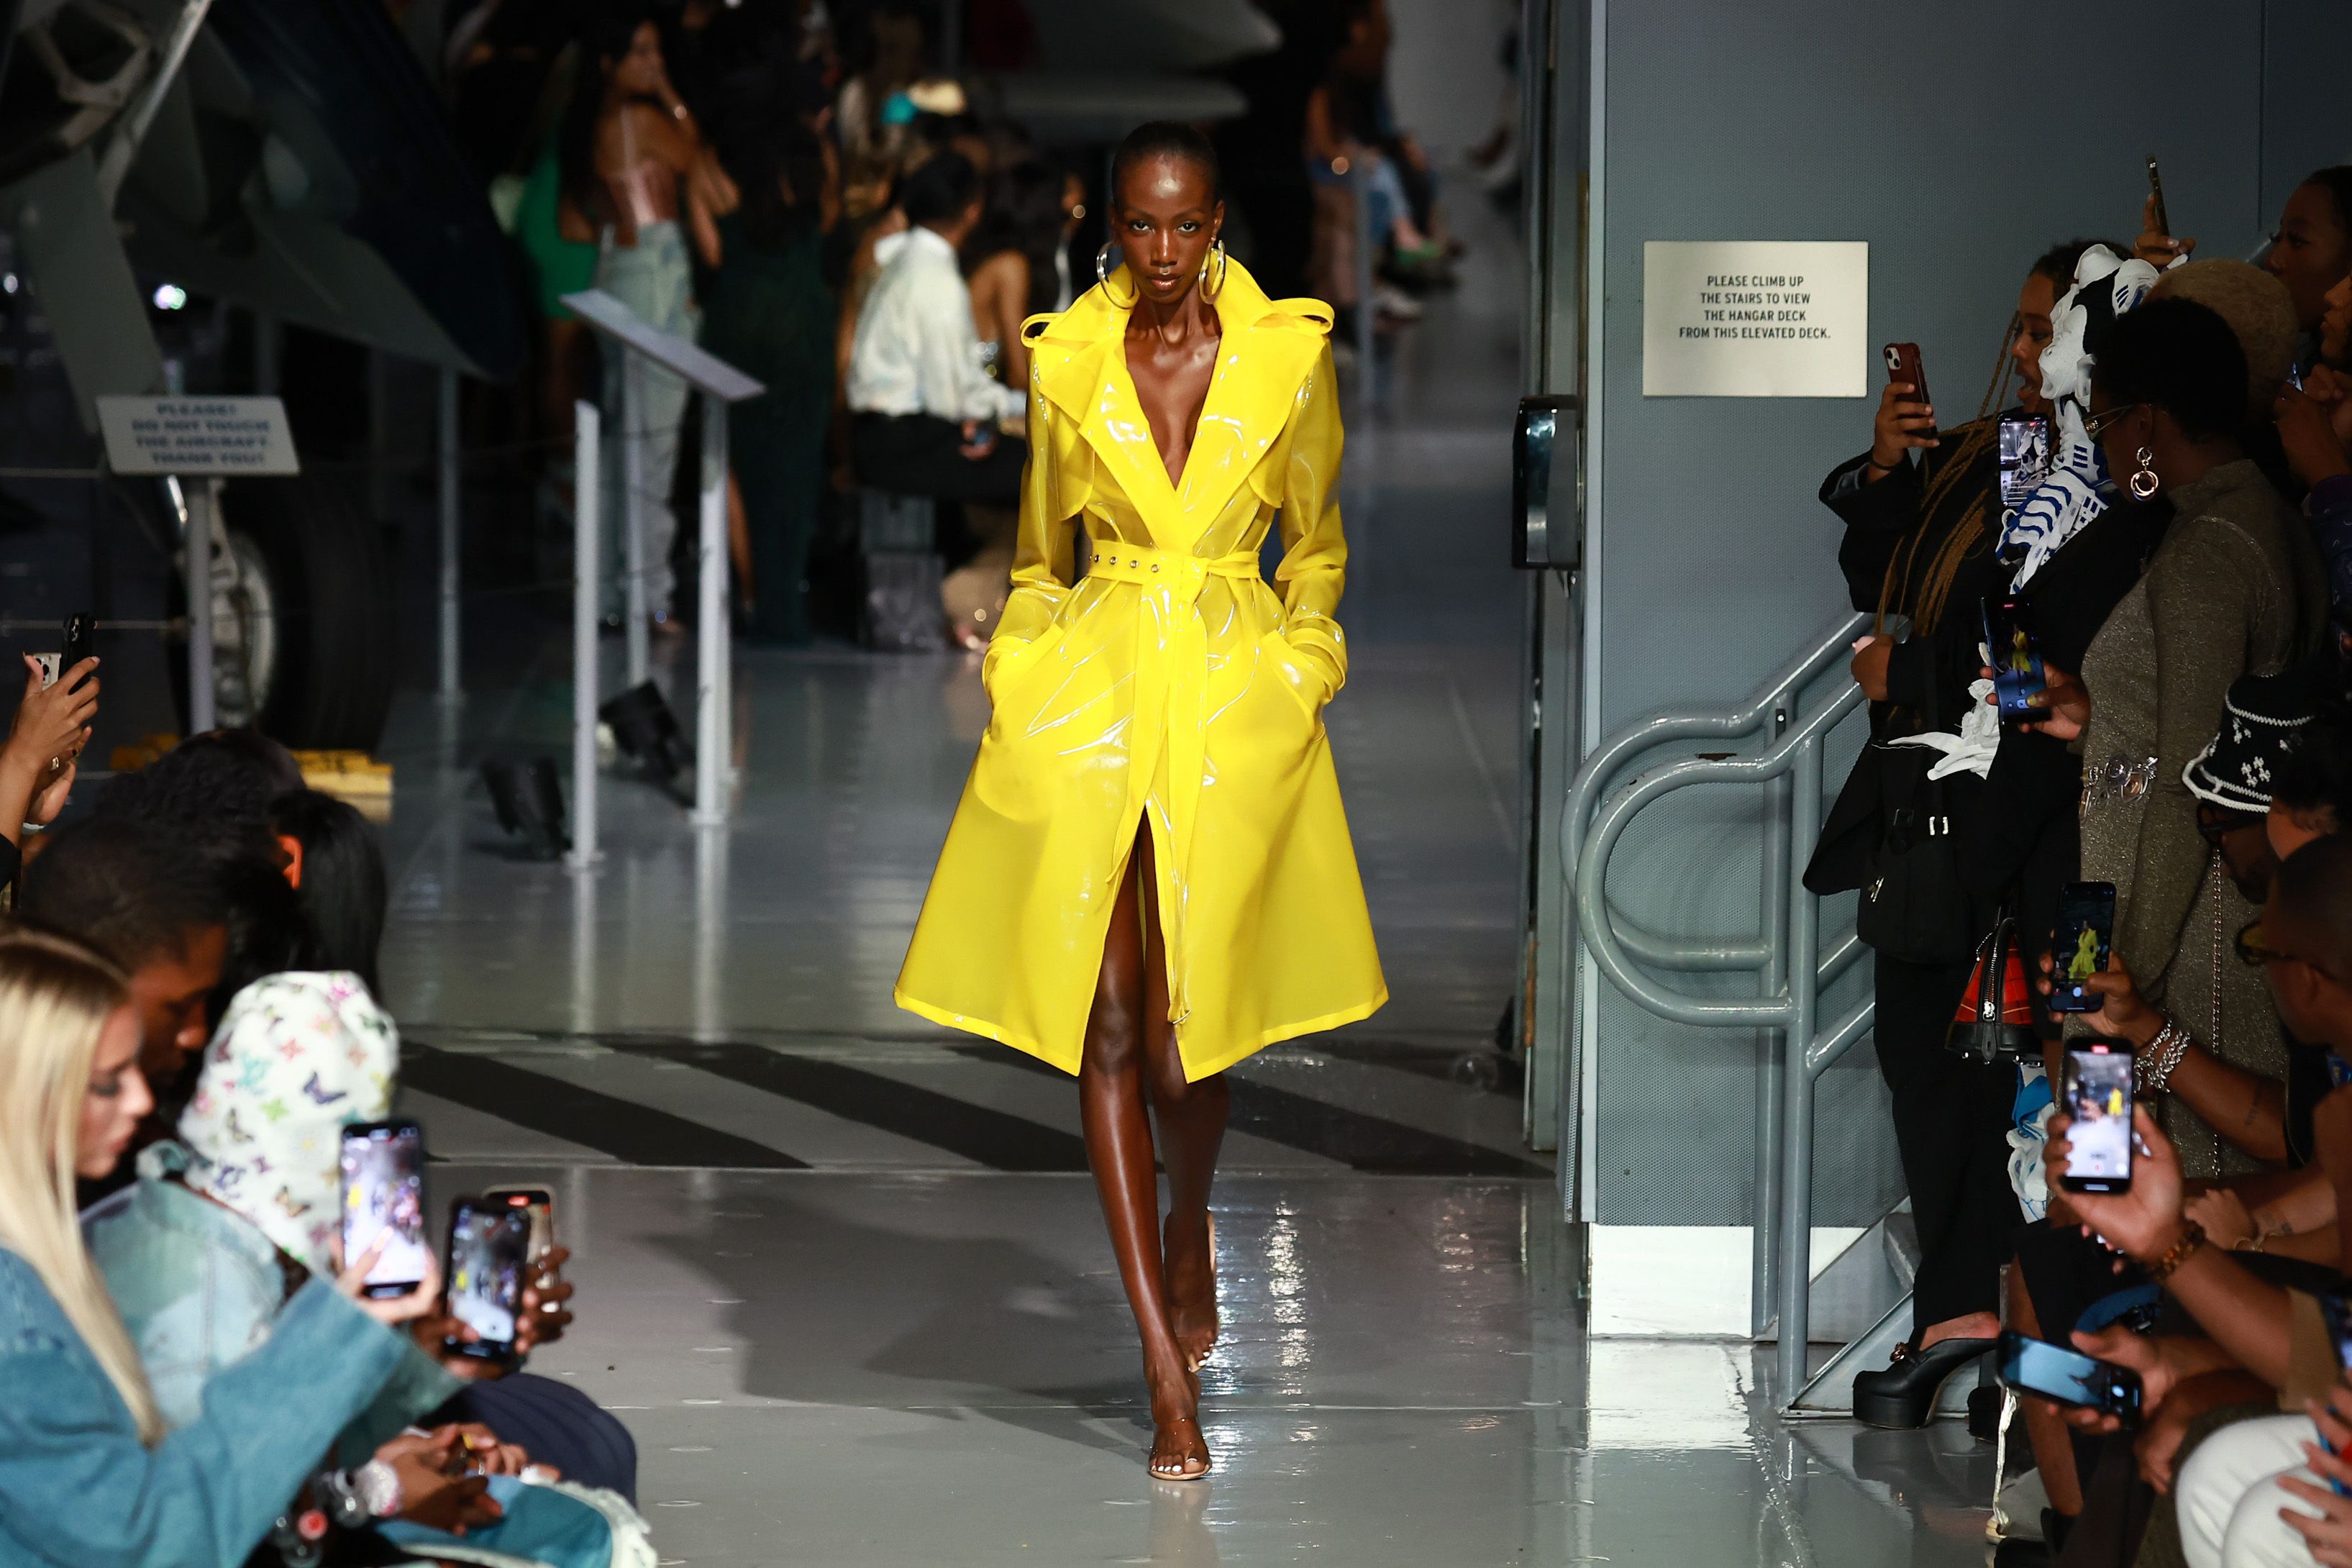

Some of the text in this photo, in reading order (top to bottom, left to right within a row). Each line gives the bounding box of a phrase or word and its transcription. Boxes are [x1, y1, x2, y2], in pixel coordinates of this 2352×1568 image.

[1708, 275, 1804, 287] PLEASE CLIMB UP
[1700, 293, 1810, 304] THE STAIRS TO VIEW
[1705, 310, 1806, 322] THE HANGAR DECK
[1679, 327, 1831, 339] FROM THIS ELEVATED DECK.
[132, 420, 270, 431] DO NOT TOUCH
[136, 436, 169, 447] THE
[152, 452, 213, 463] THANK
